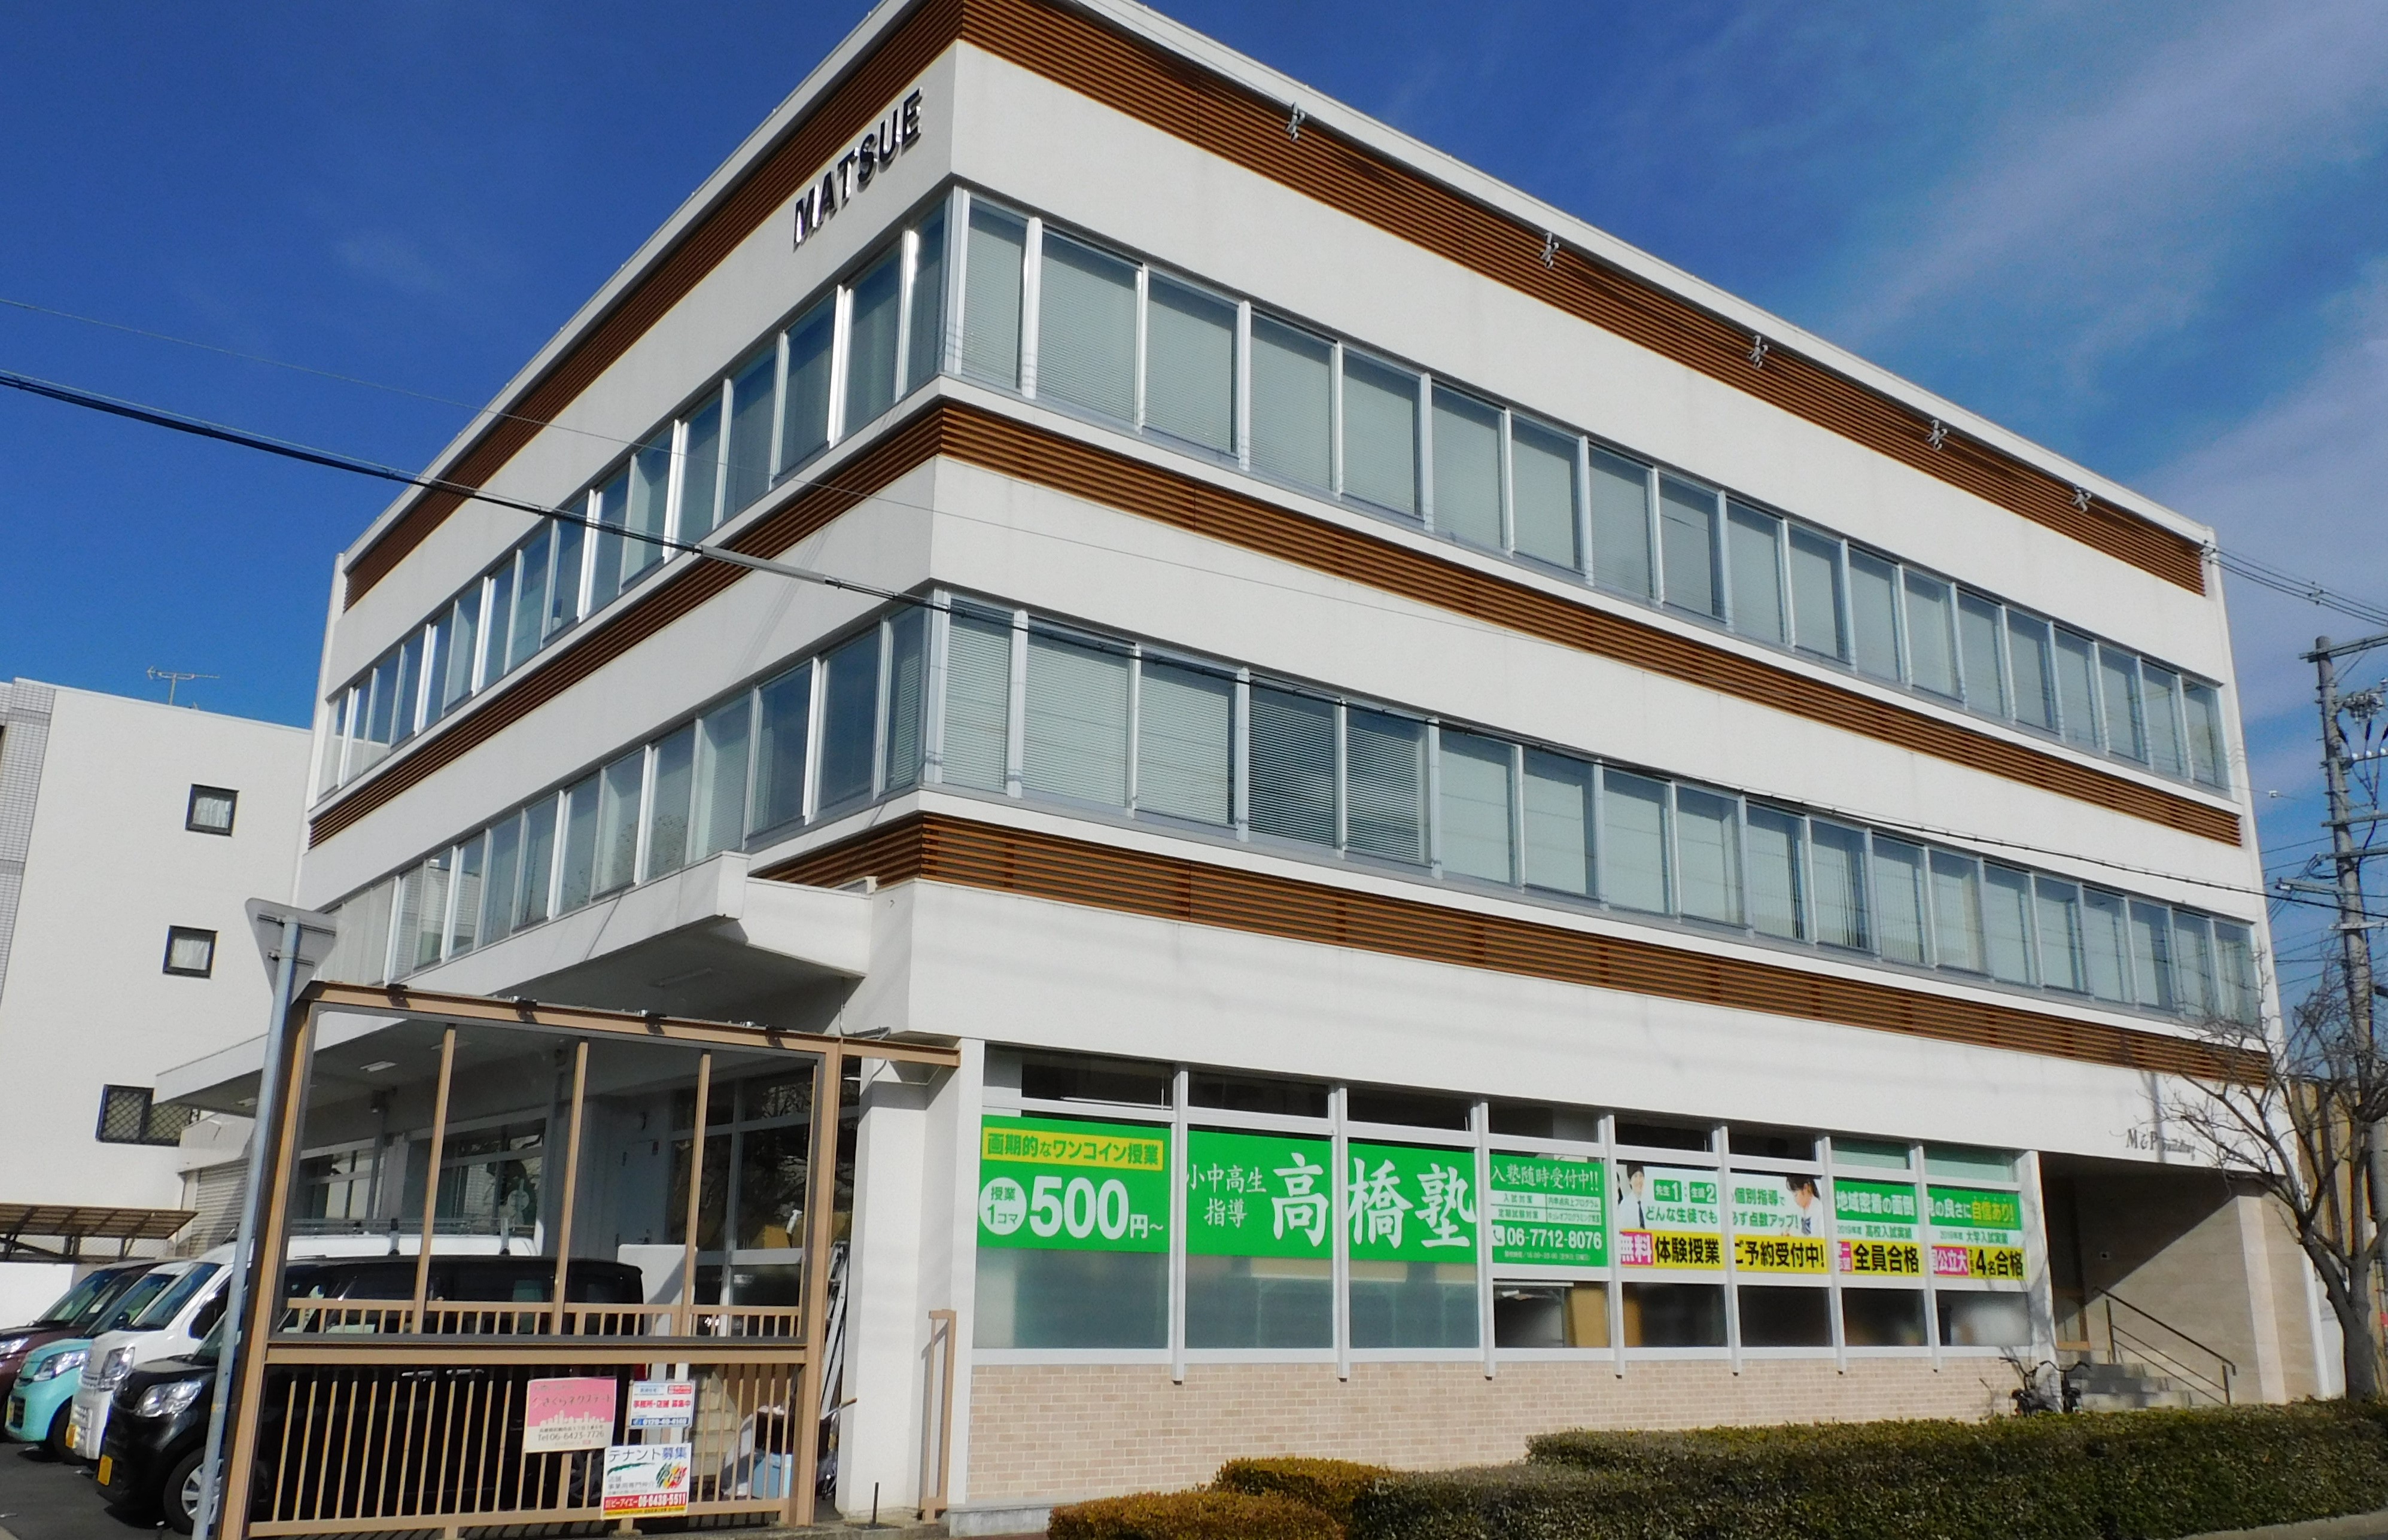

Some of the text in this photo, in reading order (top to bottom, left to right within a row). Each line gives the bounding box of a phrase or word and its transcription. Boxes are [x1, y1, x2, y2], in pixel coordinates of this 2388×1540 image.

[793, 87, 923, 250] MATSUE
[987, 1134, 1159, 1165] 画期的なワンコイン授業
[990, 1186, 1016, 1202] 授業
[1187, 1163, 1267, 1194] 小中高生
[987, 1206, 1018, 1226] 1コマ
[1204, 1198, 1248, 1229] 指導
[1272, 1153, 1477, 1249] 高橋塾
[1645, 1206, 1718, 1224] どんな生徒でも
[1507, 1227, 1602, 1250] 06-7712-8076
[1619, 1233, 1652, 1264] 無料
[1655, 1235, 1720, 1264] 体験授業
[1854, 1243, 1919, 1273] 全員合格
